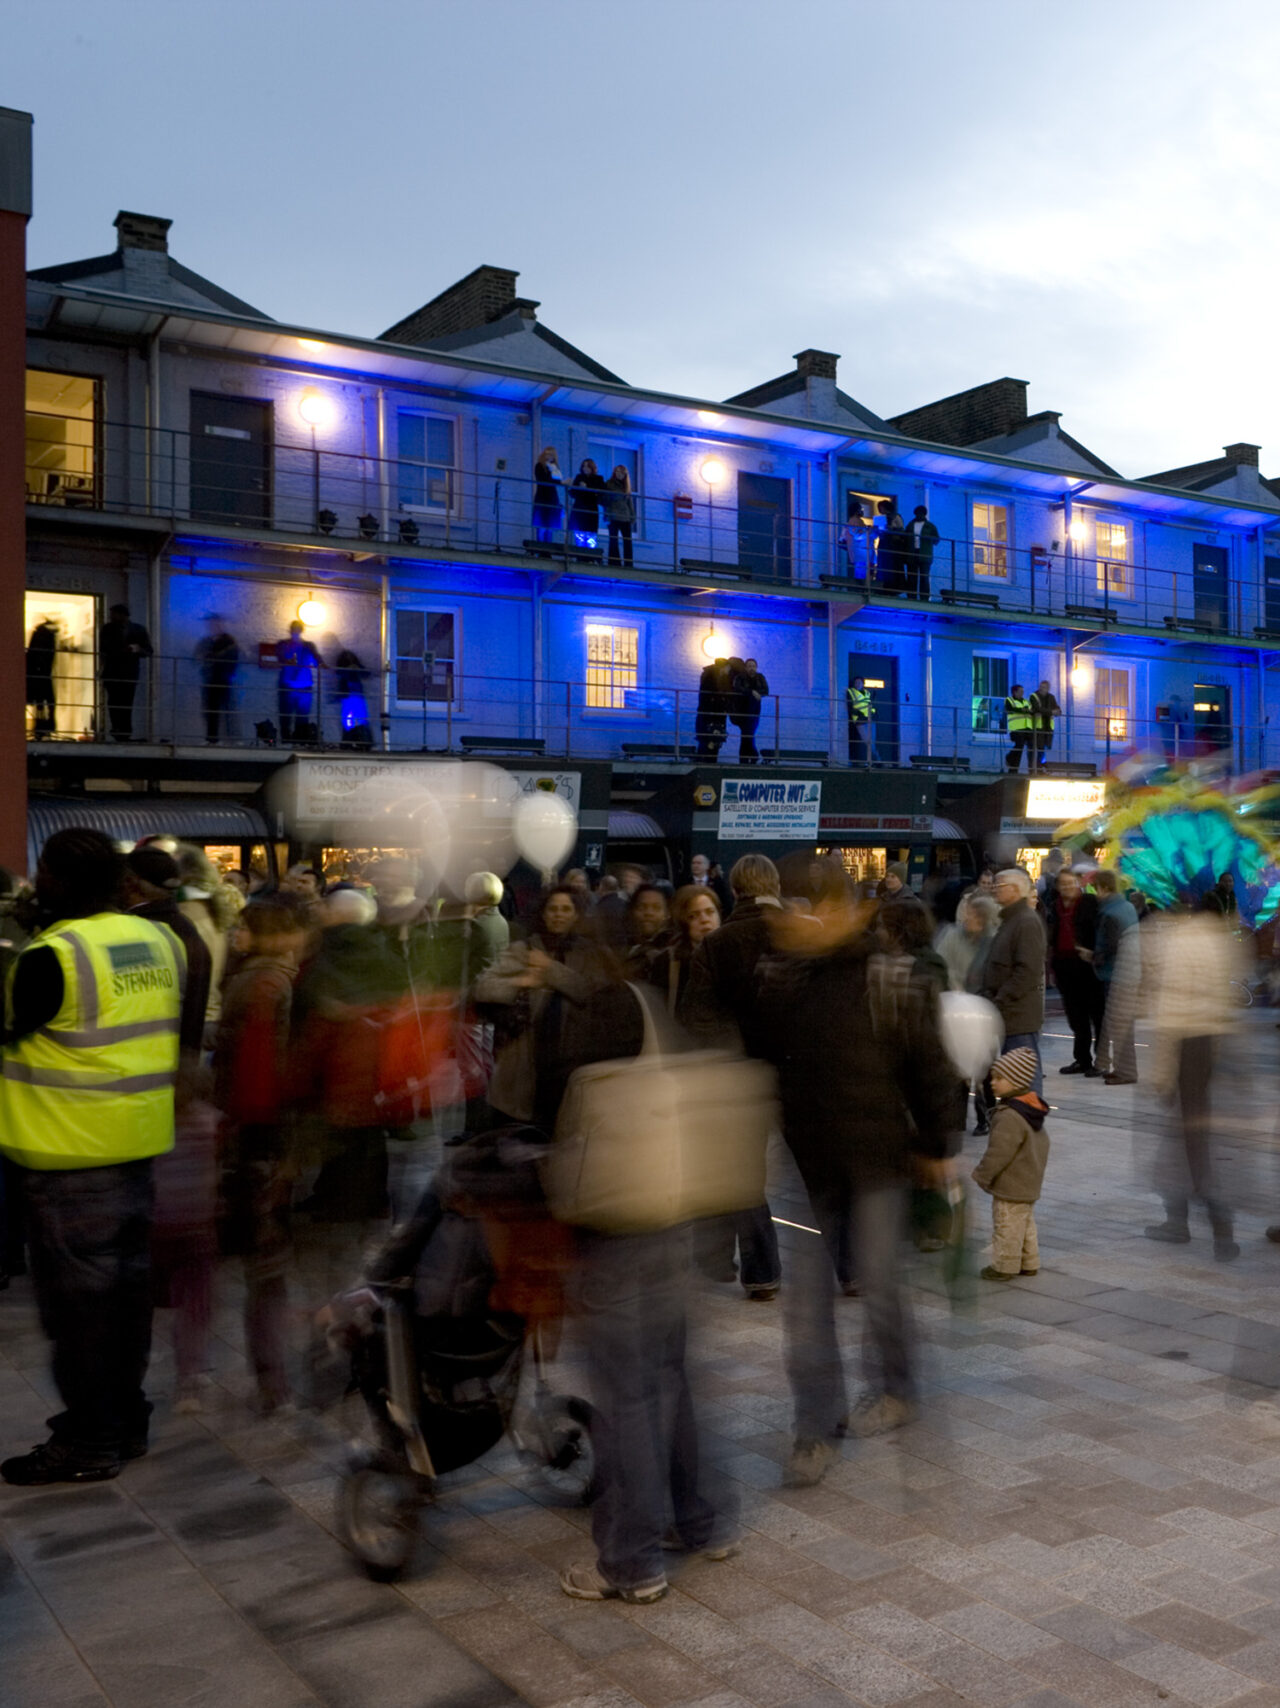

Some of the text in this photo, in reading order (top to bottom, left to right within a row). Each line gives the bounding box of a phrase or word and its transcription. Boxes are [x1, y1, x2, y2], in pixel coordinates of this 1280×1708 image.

[739, 783, 806, 803] COMPUTER HUT
[724, 804, 747, 812] SATELLITE
[798, 805, 816, 813] SERVICE
[113, 967, 174, 997] STEWARD
